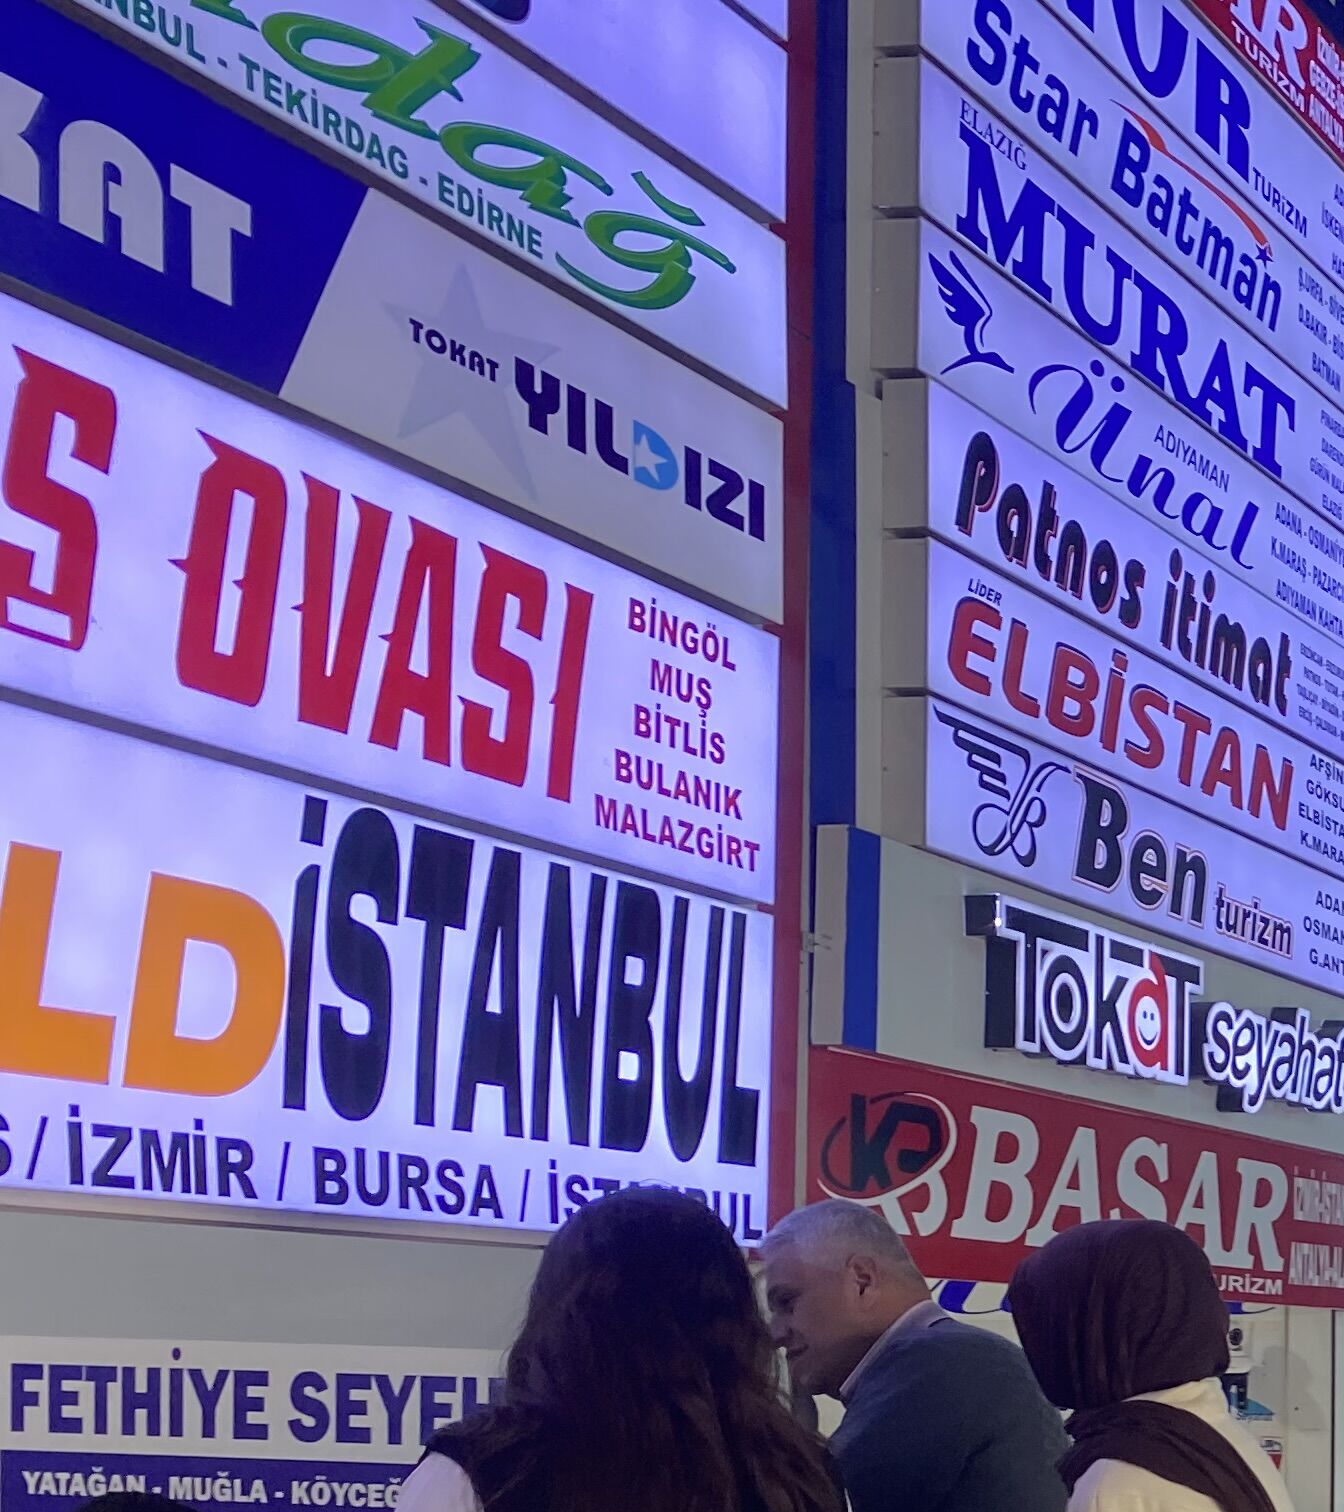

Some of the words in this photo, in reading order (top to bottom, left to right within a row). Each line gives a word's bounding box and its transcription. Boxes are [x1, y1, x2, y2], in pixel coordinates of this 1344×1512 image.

[1067, 0, 1250, 183] UR
[1231, 20, 1305, 113] TURİZM
[959, 97, 1027, 172] ELAZIĞ
[967, 0, 1099, 157] Star
[1109, 118, 1283, 332] Batman
[437, 174, 543, 259] EDİRNE
[956, 125, 1296, 479] MURAT
[409, 317, 500, 383] TOKAT
[513, 356, 766, 543] YILDIZI
[1154, 424, 1230, 493] ADIYAMAN
[168, 427, 594, 803] OVASI
[954, 431, 1146, 629] Patnos
[1160, 548, 1292, 717] itimat
[967, 577, 1003, 607] LİDER
[628, 596, 736, 672] BİNGÖL
[634, 702, 727, 766] BİTLİS
[650, 658, 712, 722] MUŞ
[948, 595, 1294, 831] ELBİSTAN
[614, 747, 743, 821] BULANIK
[1310, 753, 1344, 785] AFŞİN
[594, 793, 761, 872] MALAZGİRT
[1071, 765, 1208, 929] Ben
[282, 794, 761, 1166] İSTANBUL
[67, 1104, 258, 1199] İZMİR
[313, 1146, 503, 1220] BURSA
[1213, 1273, 1283, 1296] URİZM
[11, 1347, 270, 1441] FETHİYE
[168, 1471, 268, 1504] MUĞLA
